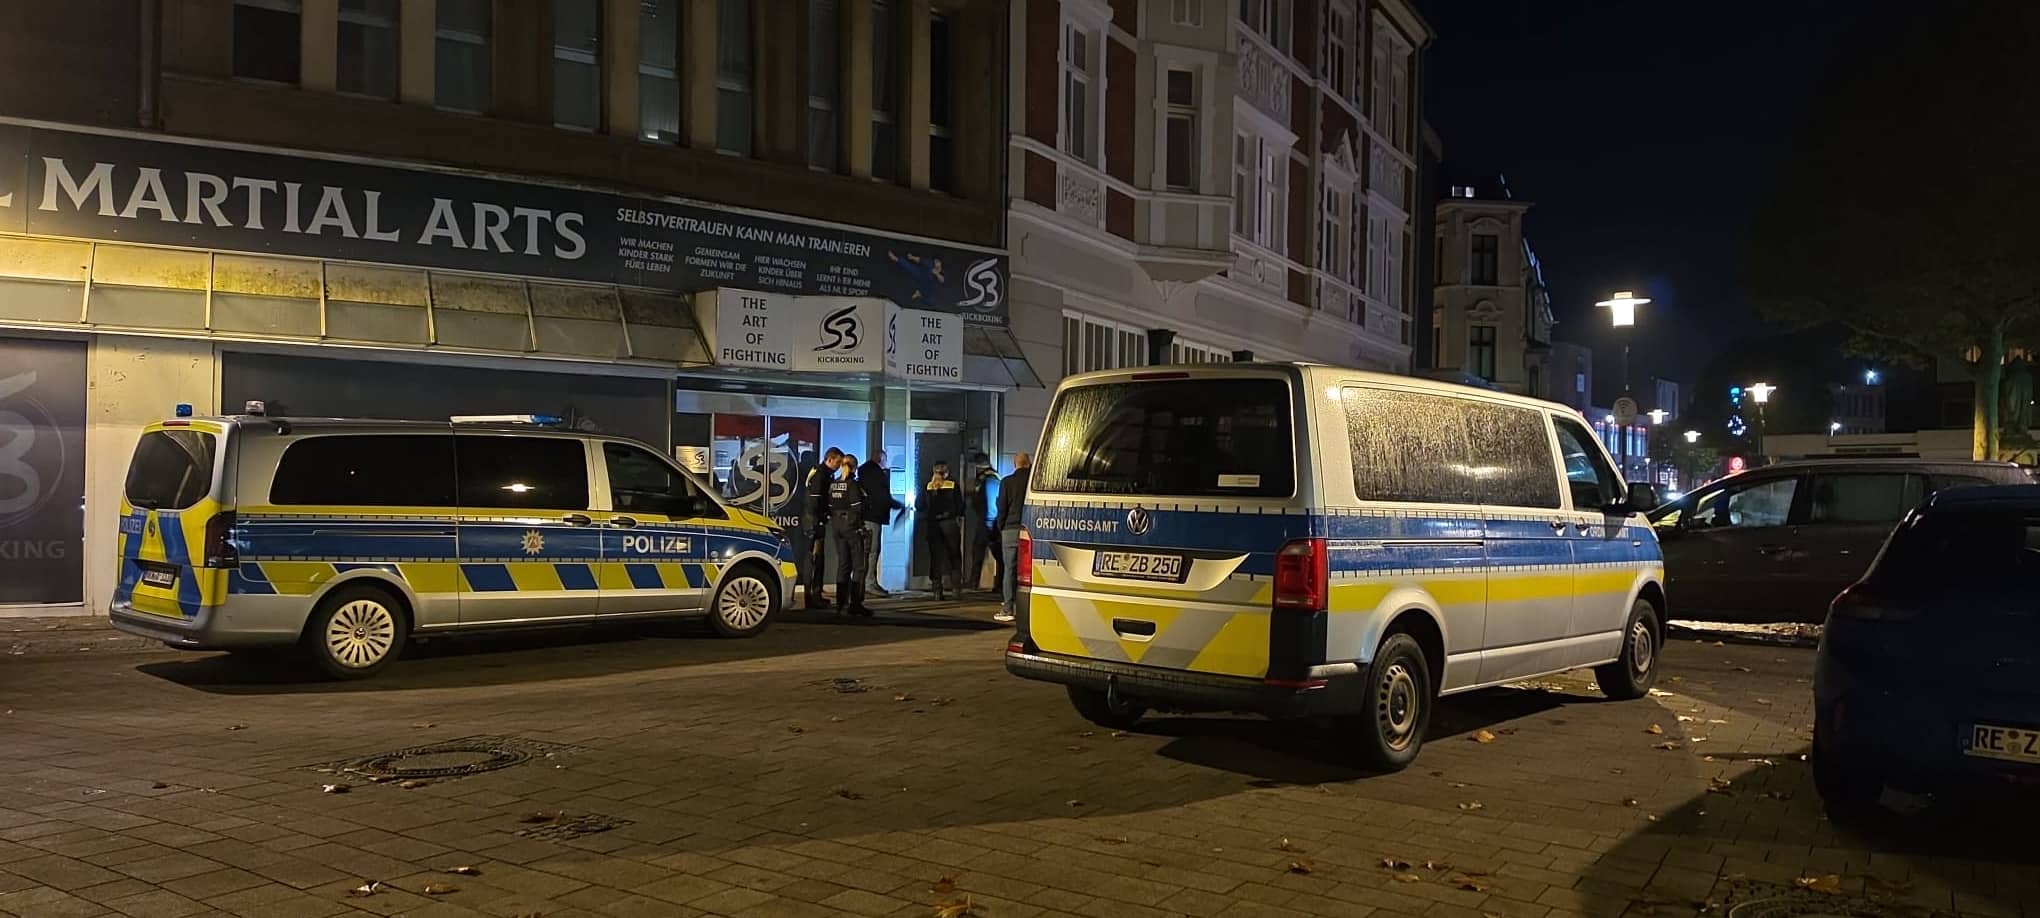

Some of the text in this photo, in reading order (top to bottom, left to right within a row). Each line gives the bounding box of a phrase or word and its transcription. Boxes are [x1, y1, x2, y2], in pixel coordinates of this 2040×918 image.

[38, 156, 587, 260] MARTIAL ARTS
[616, 208, 733, 238] SELBSTVERTRAUEN
[736, 226, 774, 244] KANN
[776, 232, 805, 249] MAN
[620, 237, 673, 251] WIR MACHEN
[619, 248, 674, 262] KINDER STARK
[695, 247, 740, 260] GEMEINSAM
[647, 261, 671, 272] LEBEN
[685, 256, 747, 272] FORMEN WIR DIE
[700, 268, 735, 280] ZUKUNFT
[741, 296, 767, 310] THE
[742, 315, 767, 328] ART
[921, 317, 942, 329] THE
[746, 333, 764, 345] OF
[922, 334, 942, 345] ART
[723, 348, 786, 364] FIGHTING
[818, 356, 864, 364] KICKBOXING
[924, 350, 940, 360] OF
[906, 364, 958, 378] FIGHTING
[1036, 518, 1119, 533] ORDNUNGSAMT
[623, 536, 691, 554] POLIZEI
[1102, 554, 1121, 571] RE
[1129, 556, 1149, 572] ZB
[1151, 557, 1180, 575] 250
[1975, 728, 2004, 750] RE
